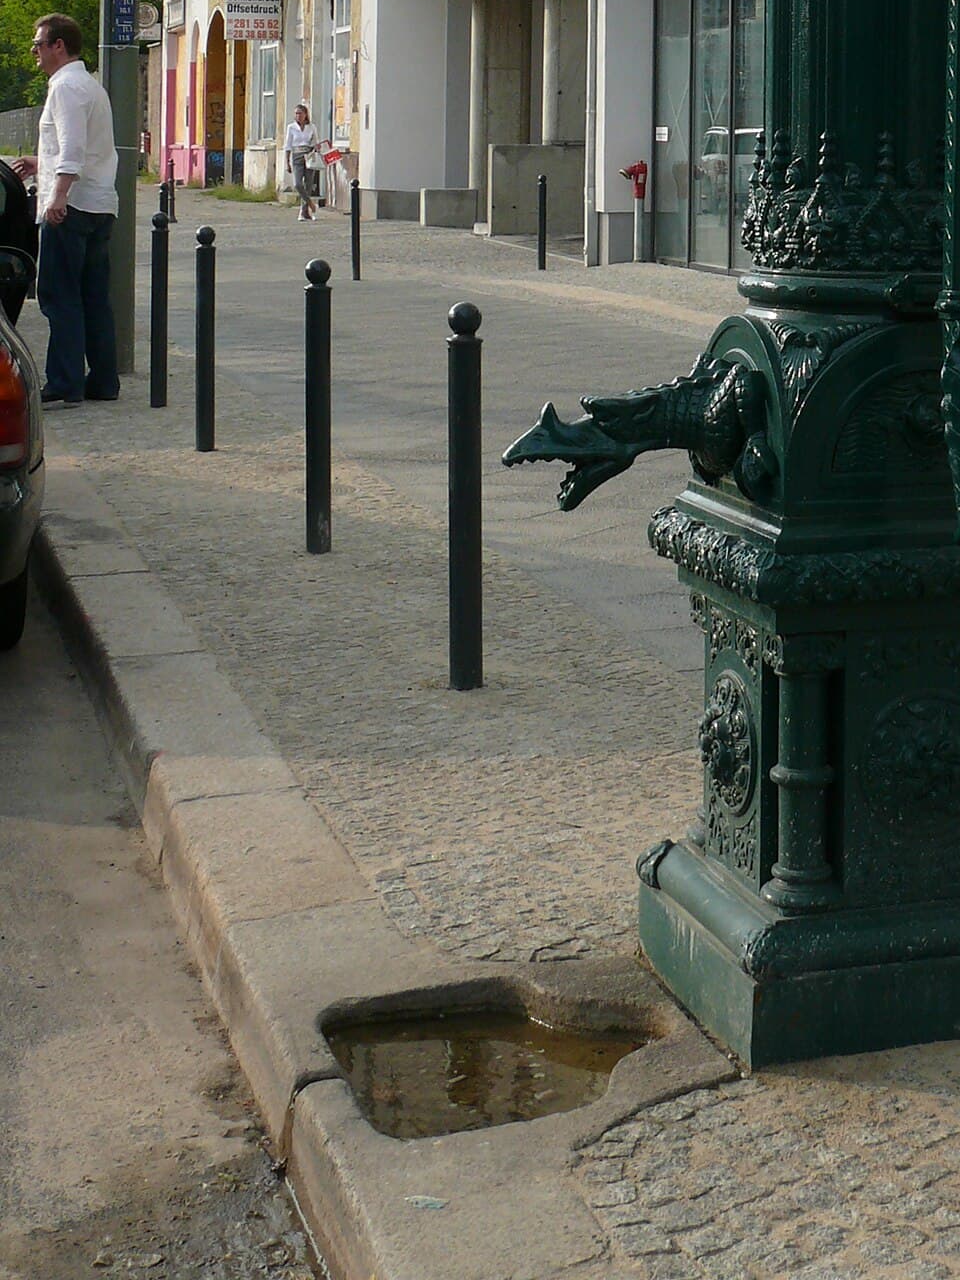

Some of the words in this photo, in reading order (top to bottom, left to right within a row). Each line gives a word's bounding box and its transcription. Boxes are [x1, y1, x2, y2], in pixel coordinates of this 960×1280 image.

[227, 4, 279, 13] Offsetdruck
[234, 19, 250, 29] 281
[253, 19, 265, 29] 55
[267, 19, 279, 29] 62
